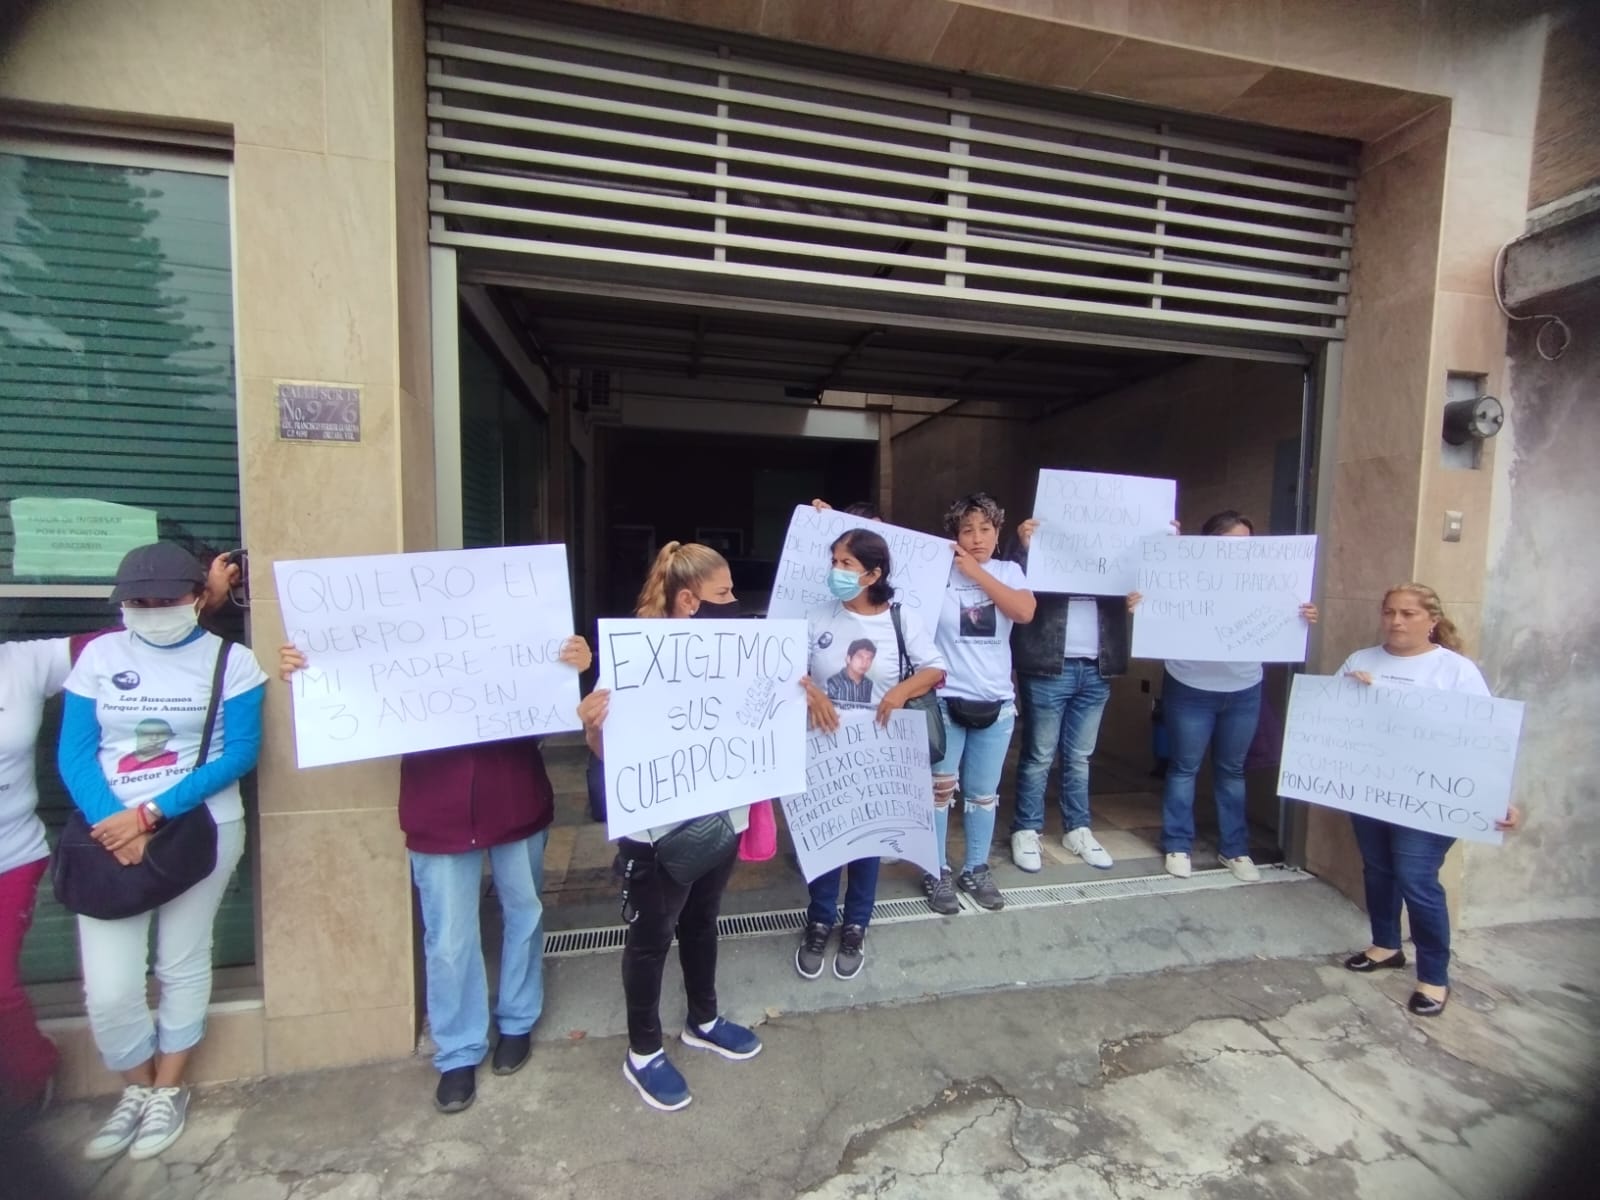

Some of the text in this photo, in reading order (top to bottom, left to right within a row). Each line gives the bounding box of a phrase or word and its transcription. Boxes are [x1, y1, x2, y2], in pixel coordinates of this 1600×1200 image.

[305, 400, 359, 424] 976
[785, 534, 805, 553] DE
[1142, 541, 1168, 562] ES
[1176, 540, 1207, 561] SU
[782, 558, 826, 585] TENG
[1136, 568, 1299, 593] HACER SU TRABAJO
[287, 564, 476, 614] QUIERO
[776, 584, 796, 601] EN
[291, 613, 497, 653] CUERPO DE
[300, 668, 341, 698] MI
[369, 649, 482, 693] PADRE
[608, 631, 796, 691] EXIGIMOS
[102, 703, 140, 712] Porque
[160, 704, 208, 712] Amamos
[119, 694, 193, 703] Los Buscamos
[319, 679, 518, 740] 3 AÑOS EN
[667, 695, 723, 731] SUS
[475, 703, 570, 739] ESPERA
[806, 732, 839, 761] JEN
[845, 723, 865, 745] DE
[879, 745, 897, 763] SE
[616, 729, 777, 814] CUERPOS!!!
[1429, 773, 1476, 799] NO
[790, 790, 853, 833] GENETICOS
[850, 800, 884, 826] ALGO
[885, 798, 906, 818] LES
[1280, 769, 1490, 832] PONGAN PRETEXTOS
